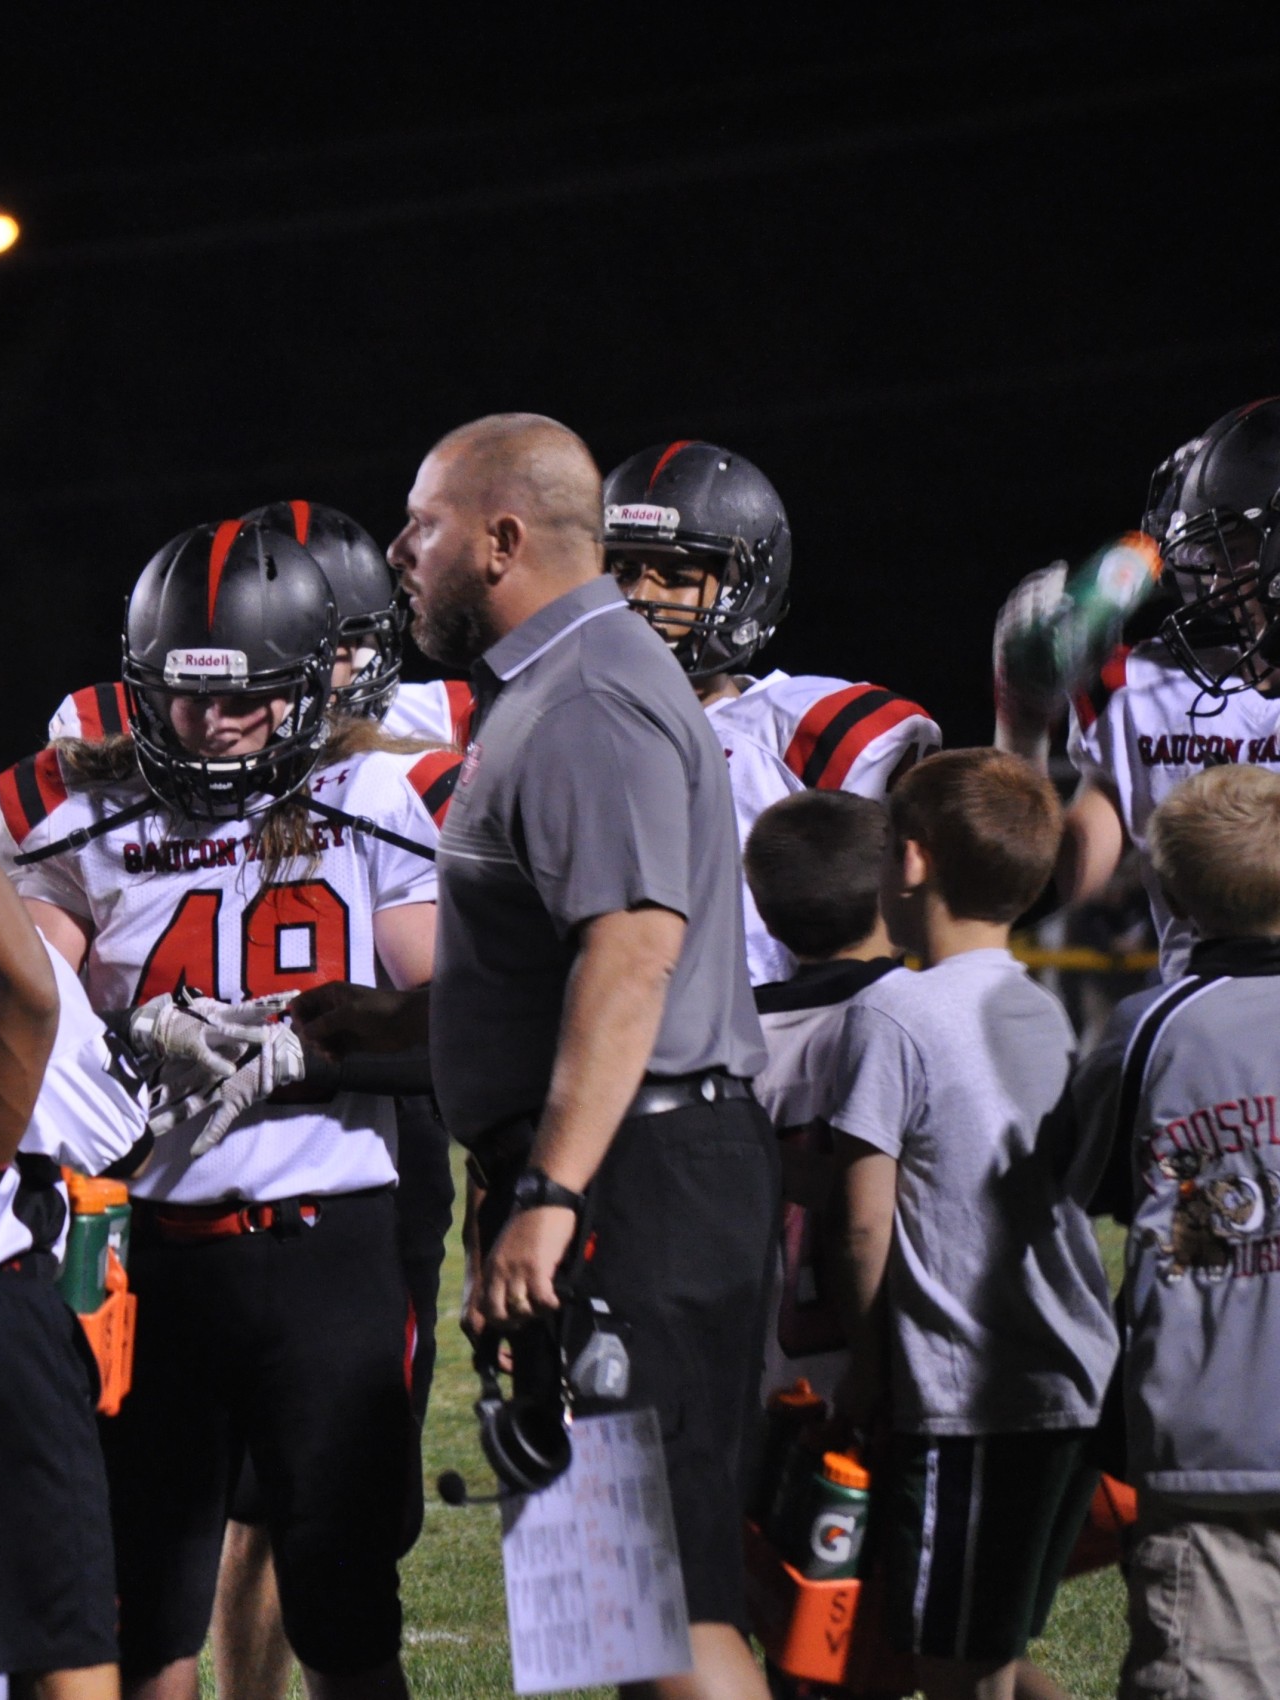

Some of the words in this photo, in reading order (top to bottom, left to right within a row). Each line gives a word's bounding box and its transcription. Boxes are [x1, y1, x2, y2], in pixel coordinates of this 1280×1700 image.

[621, 508, 662, 522] Riddell
[185, 654, 230, 667] Riddell
[123, 837, 237, 874] SAUCON
[811, 1512, 856, 1563] G
